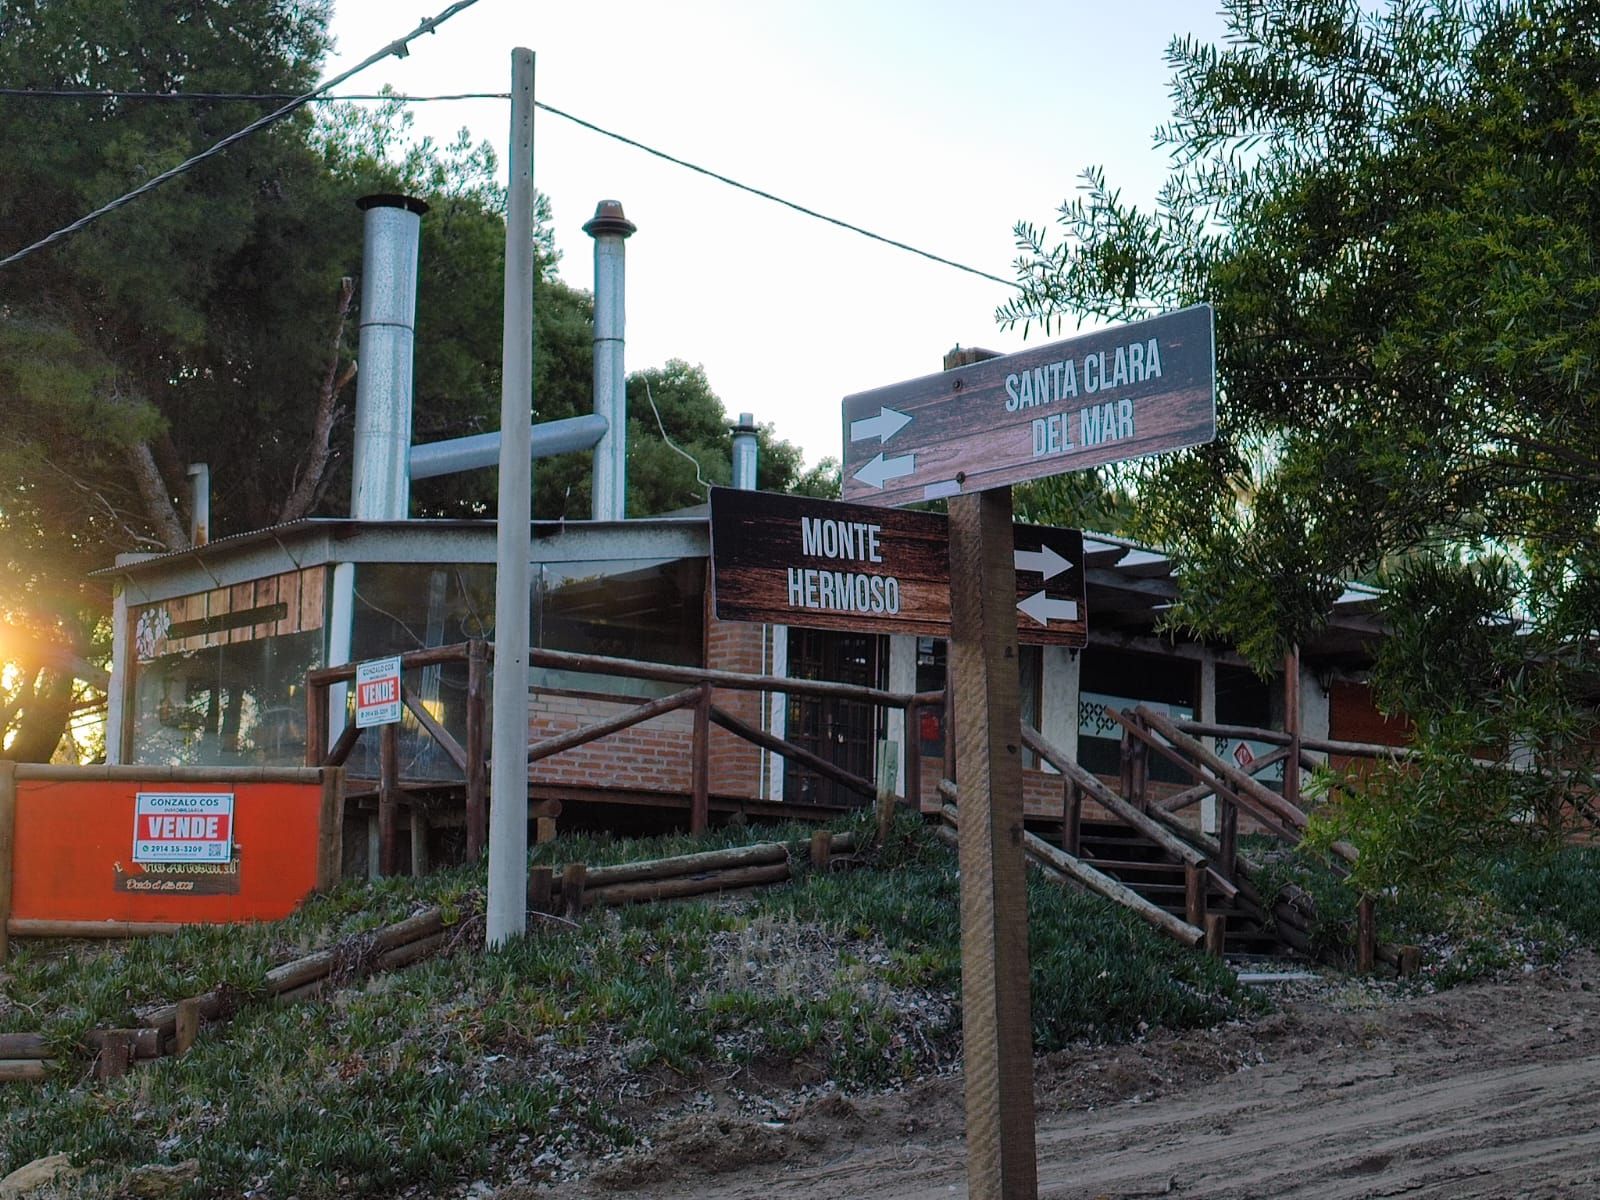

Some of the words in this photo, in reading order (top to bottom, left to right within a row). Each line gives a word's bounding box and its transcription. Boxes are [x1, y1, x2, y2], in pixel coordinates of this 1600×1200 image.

[1004, 359, 1077, 413] SANTA
[1084, 337, 1163, 394] CLARA
[1031, 414, 1074, 458] DEL
[1081, 399, 1135, 447] MAR
[801, 516, 883, 564] MONTE
[787, 567, 900, 616] HERMOSO
[362, 680, 394, 705] VENDE
[150, 798, 197, 807] GONZALO
[199, 798, 219, 807] COS
[148, 816, 219, 839] VENDE
[151, 845, 169, 853] 2914
